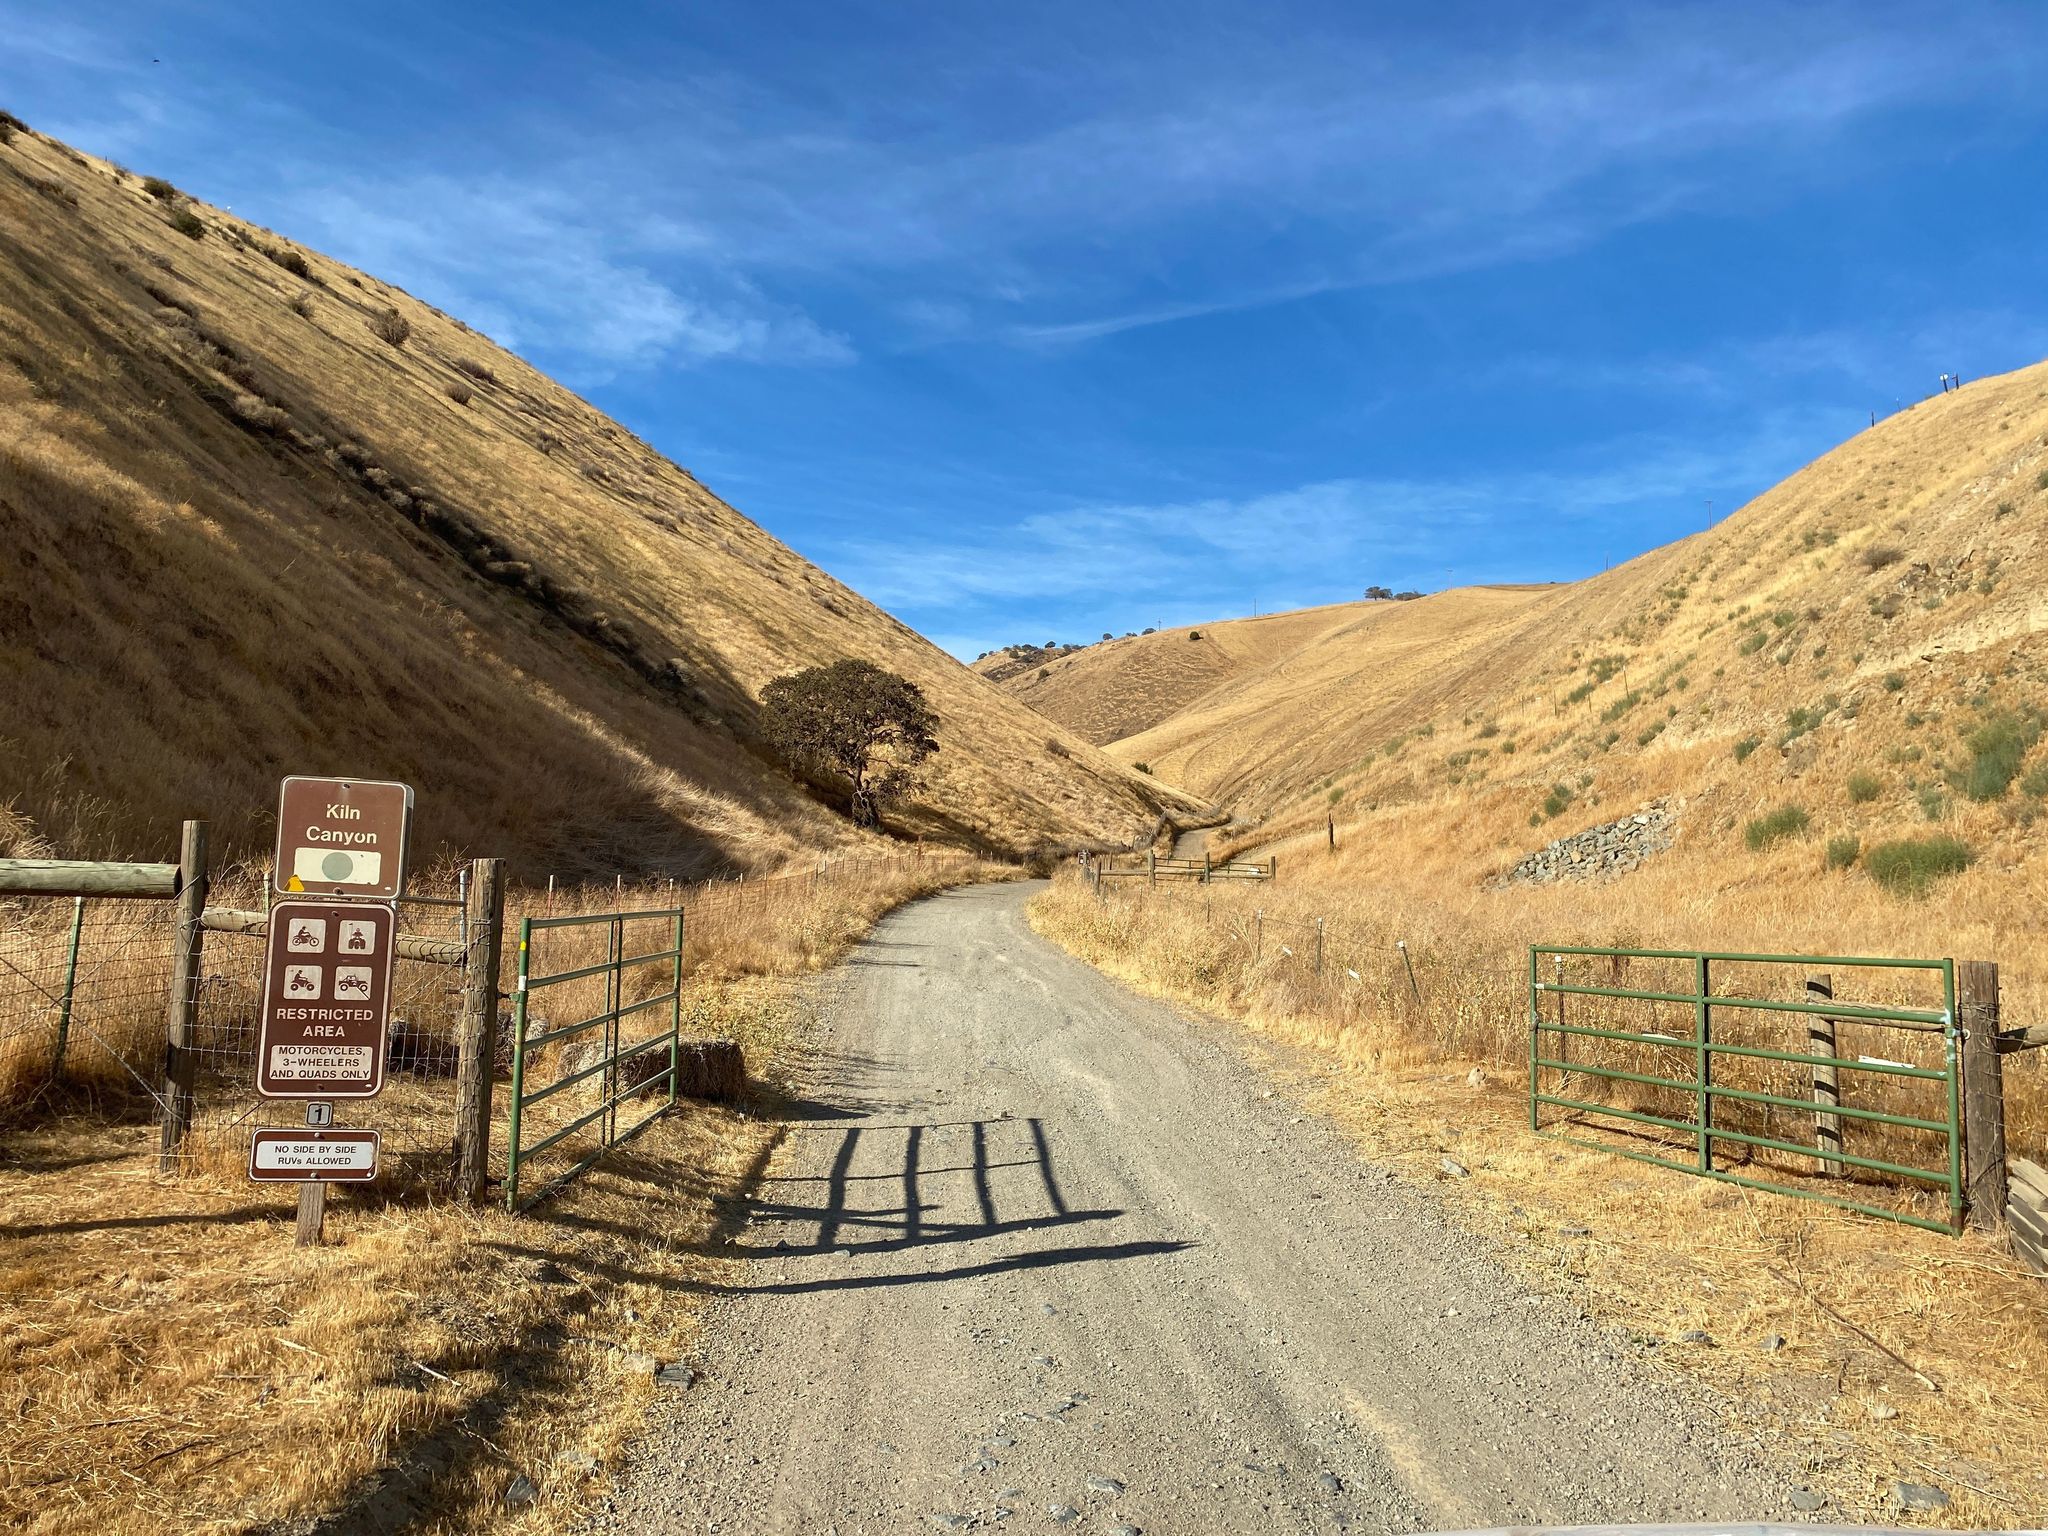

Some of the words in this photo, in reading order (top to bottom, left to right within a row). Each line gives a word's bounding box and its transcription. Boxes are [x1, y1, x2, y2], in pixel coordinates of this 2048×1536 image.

[326, 804, 361, 820] Kiln
[306, 826, 377, 845] Canyon
[276, 1008, 373, 1021] RESTRICTED
[302, 1026, 345, 1037] AREA
[278, 1046, 366, 1056] MOTORCYCLES,
[283, 1058, 359, 1067] 3-WHEELERS
[270, 1070, 294, 1078] AND
[298, 1070, 337, 1079] QUADS
[341, 1070, 369, 1079] ONLY
[314, 1108, 322, 1122] 1
[274, 1145, 289, 1153] NO
[293, 1145, 315, 1153] SIDE
[318, 1145, 331, 1153] BY
[335, 1145, 357, 1153] SIDE
[277, 1157, 302, 1165] RUVs
[306, 1157, 352, 1165] ALLOWED
